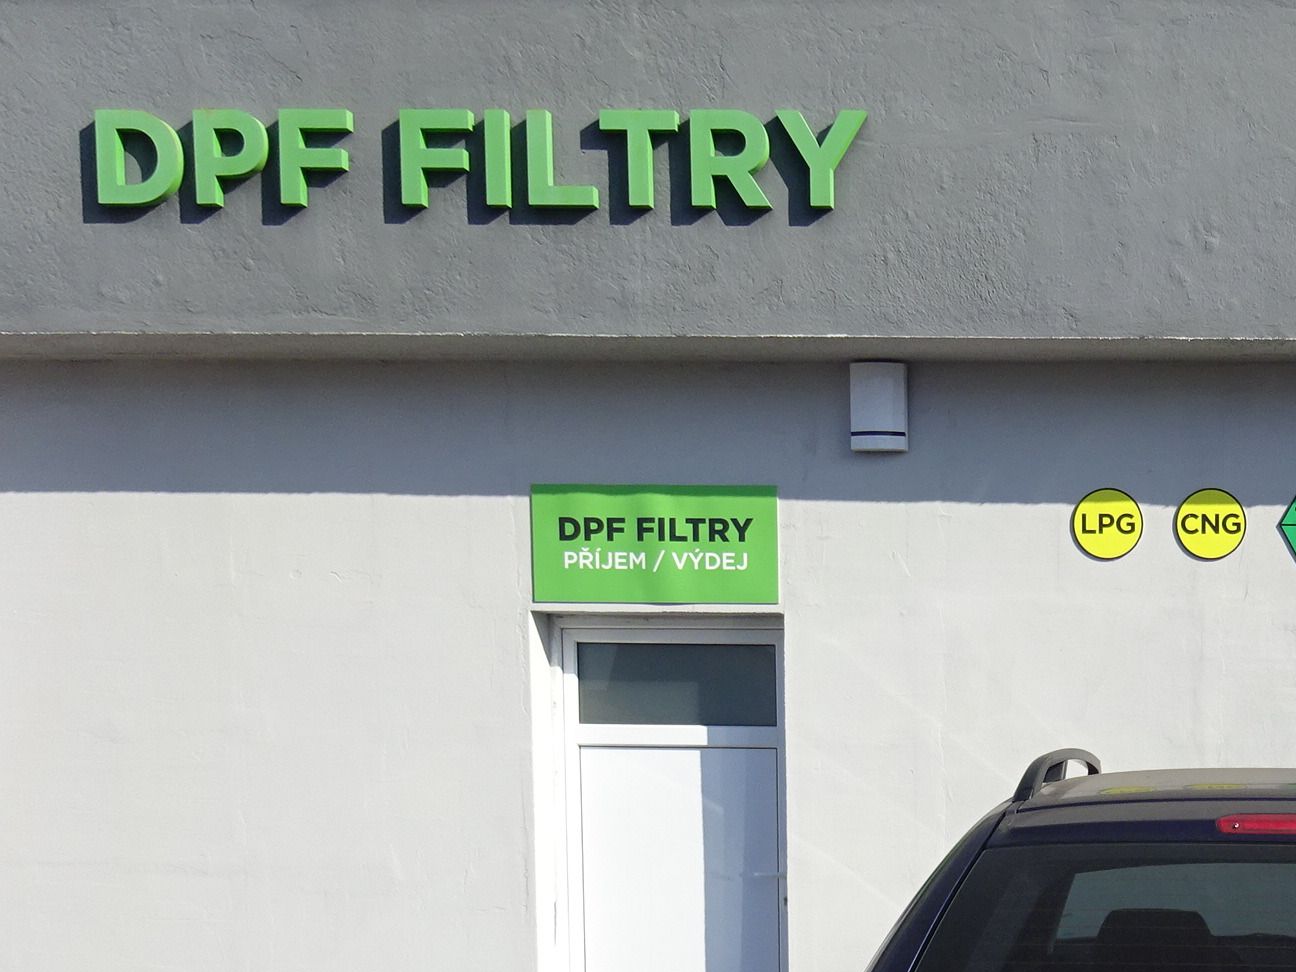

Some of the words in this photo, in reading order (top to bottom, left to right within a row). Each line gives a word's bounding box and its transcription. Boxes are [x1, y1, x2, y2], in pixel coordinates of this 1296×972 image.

[93, 108, 354, 208] DPF
[400, 108, 868, 209] FILTRY
[558, 517, 626, 542] DPF
[636, 517, 754, 543] FILTRY
[1081, 513, 1136, 535] LPG
[1181, 513, 1242, 535] CNG
[564, 547, 647, 570] PŘÍJEM
[652, 550, 665, 572] /
[672, 548, 749, 571] VÝDEJ
